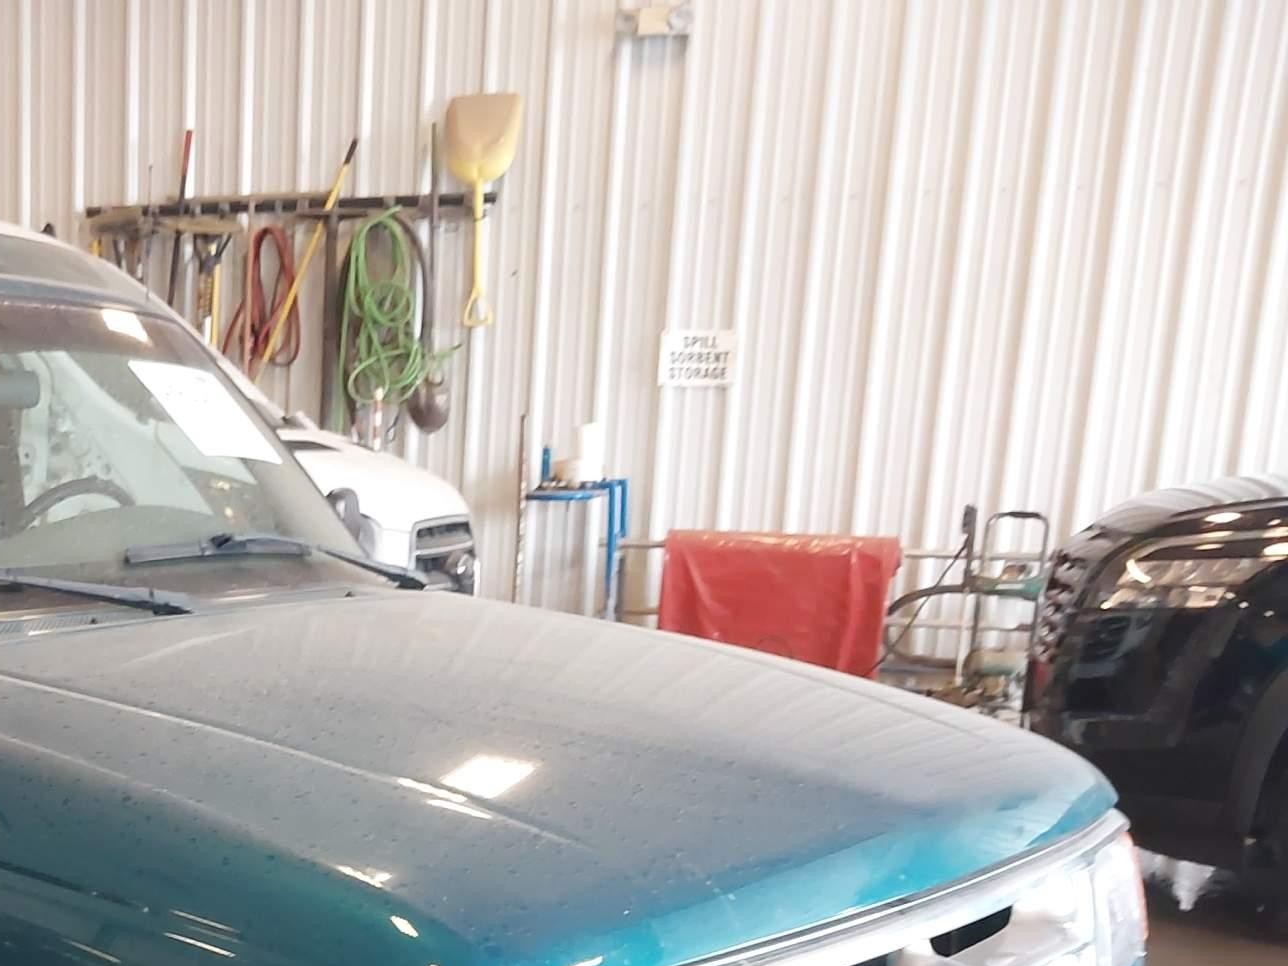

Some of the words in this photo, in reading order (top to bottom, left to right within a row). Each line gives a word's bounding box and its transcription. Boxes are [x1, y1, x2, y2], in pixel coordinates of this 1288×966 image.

[683, 335, 718, 349] SPILL
[670, 351, 730, 365] SORBENT
[668, 367, 728, 380] STORAGE
